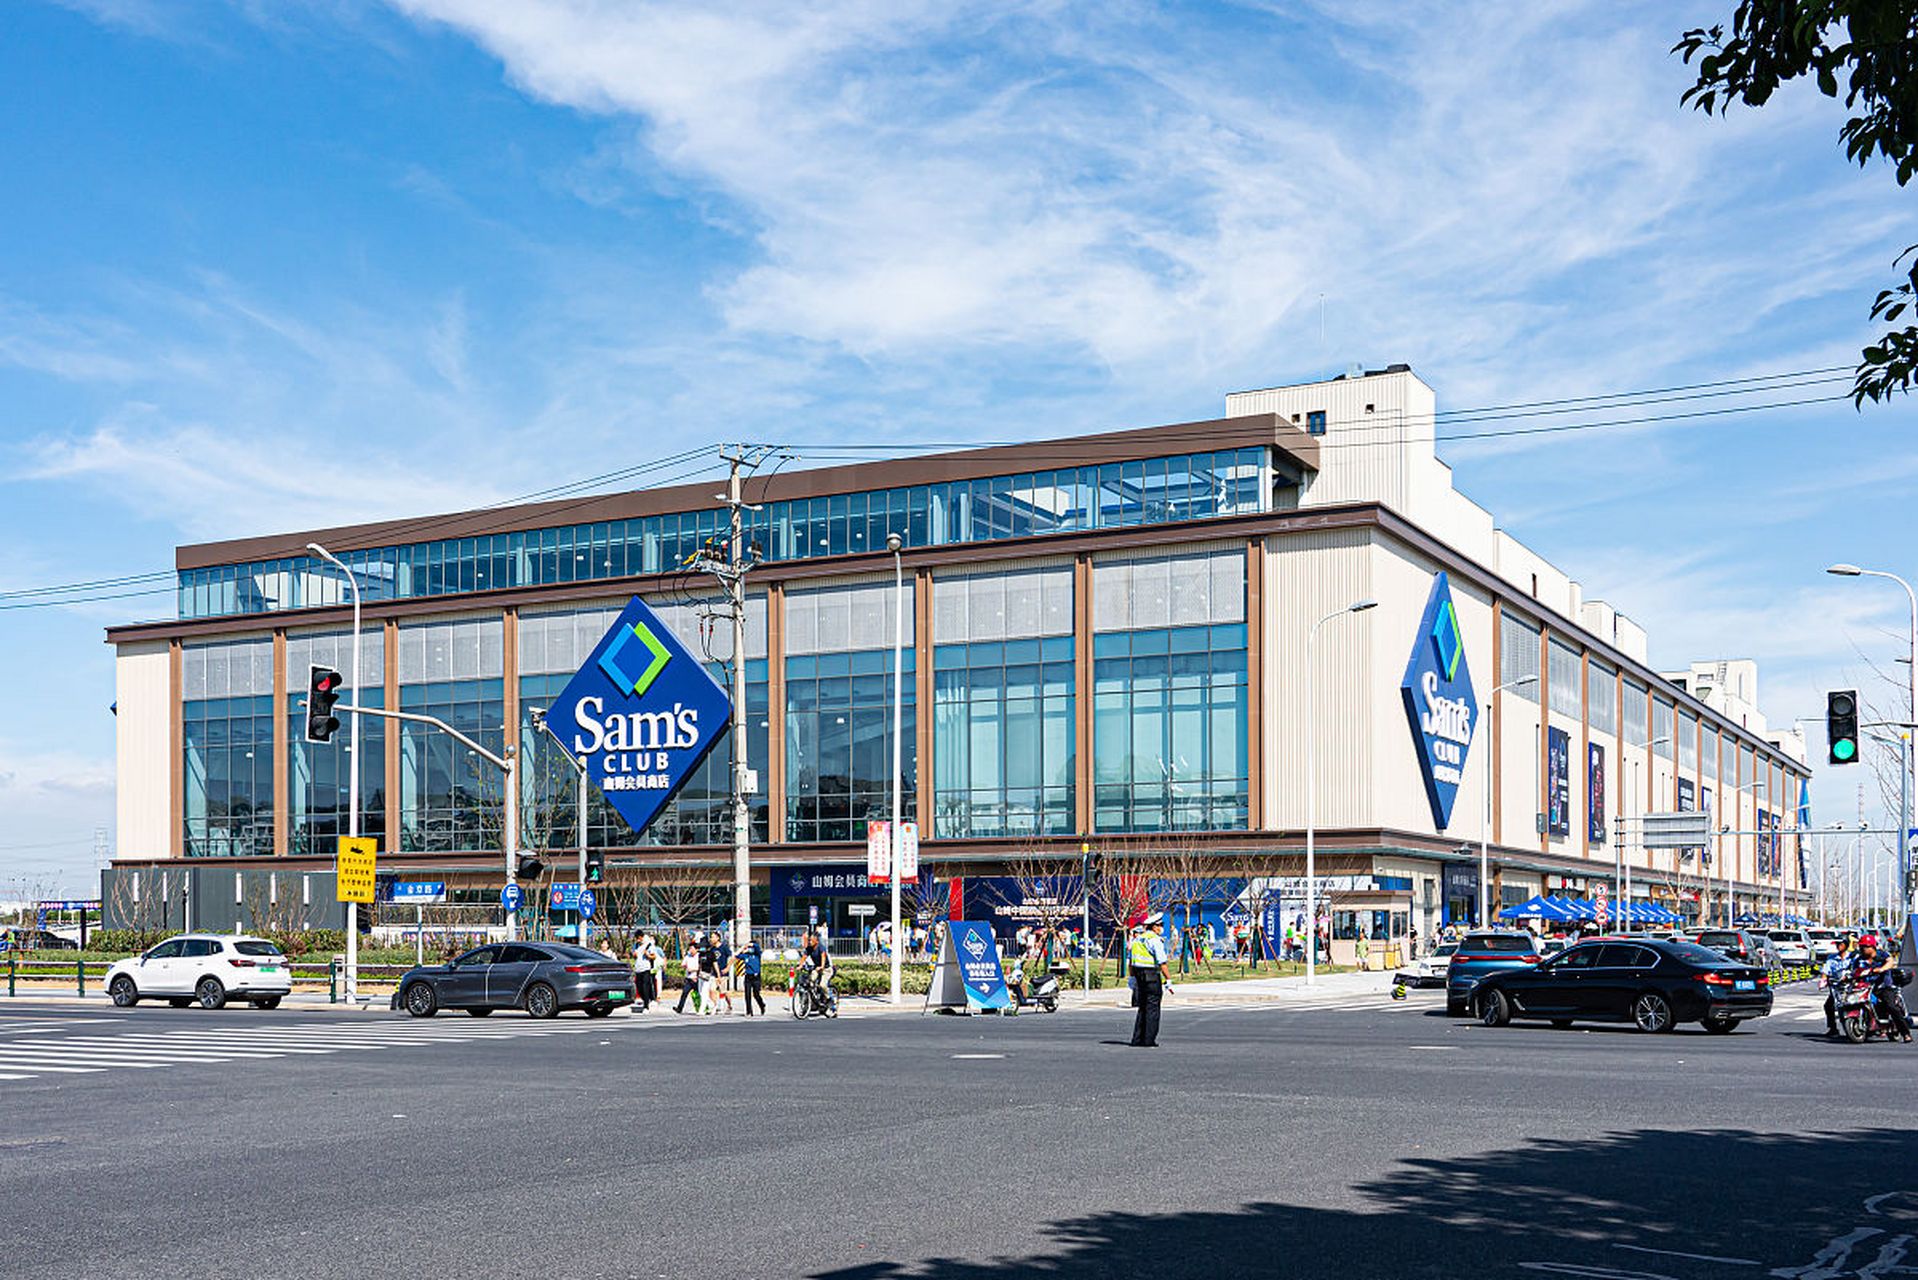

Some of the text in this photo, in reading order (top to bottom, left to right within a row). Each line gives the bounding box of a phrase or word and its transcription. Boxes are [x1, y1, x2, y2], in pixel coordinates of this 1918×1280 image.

[575, 696, 699, 754] Sam's
[1422, 671, 1470, 745] Sam's
[603, 752, 669, 773] CLUB
